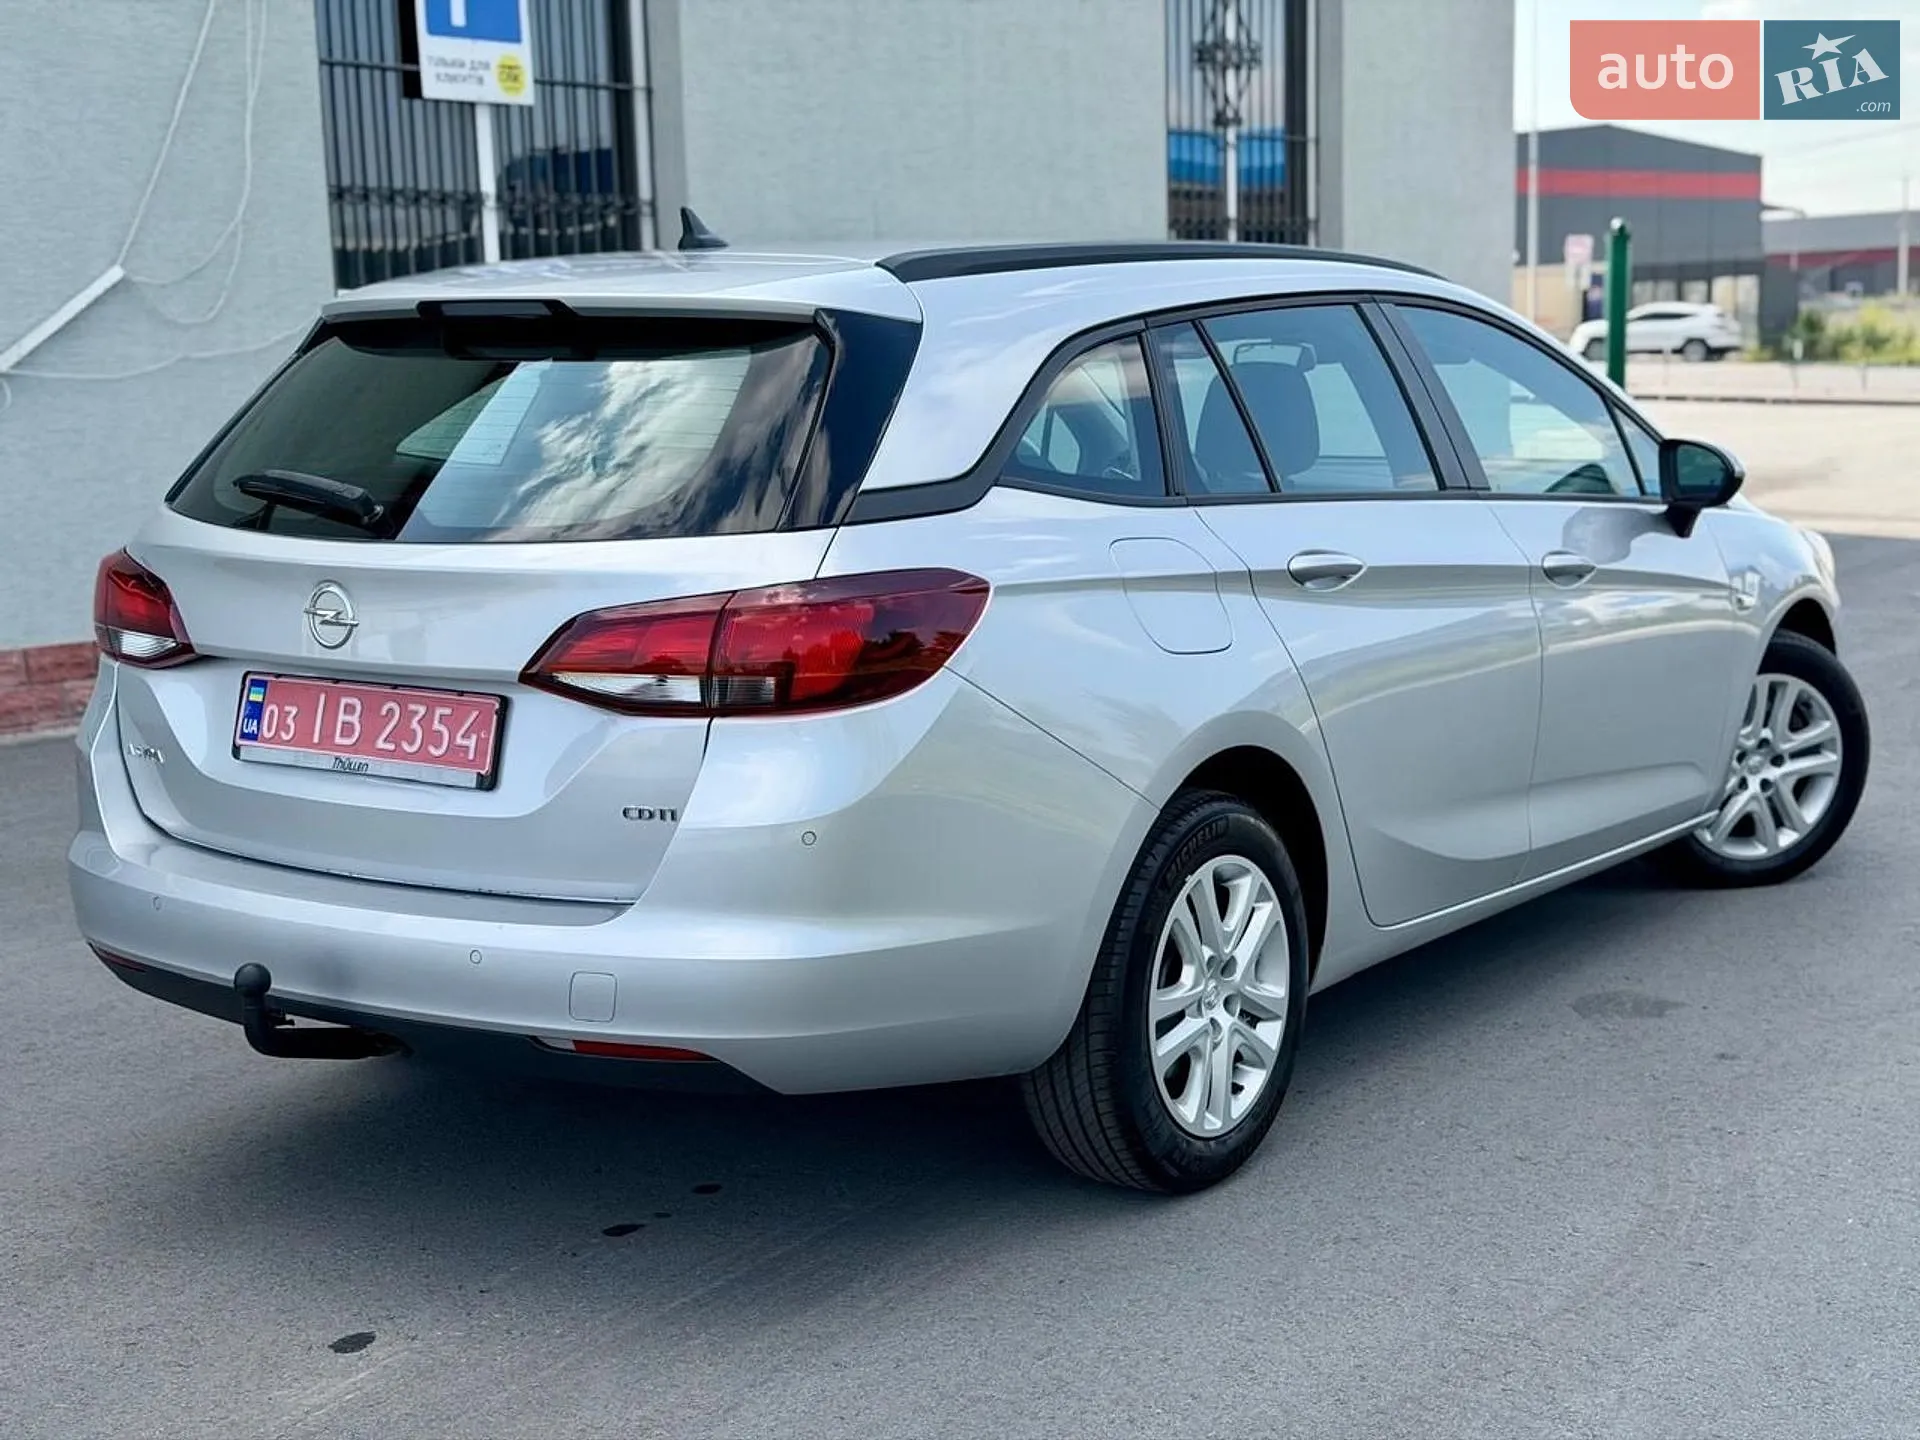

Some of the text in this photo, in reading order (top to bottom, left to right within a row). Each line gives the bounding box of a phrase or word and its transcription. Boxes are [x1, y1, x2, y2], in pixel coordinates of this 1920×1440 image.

[243, 719, 258, 734] UA
[262, 703, 298, 741] 03
[375, 701, 480, 760] 2354
